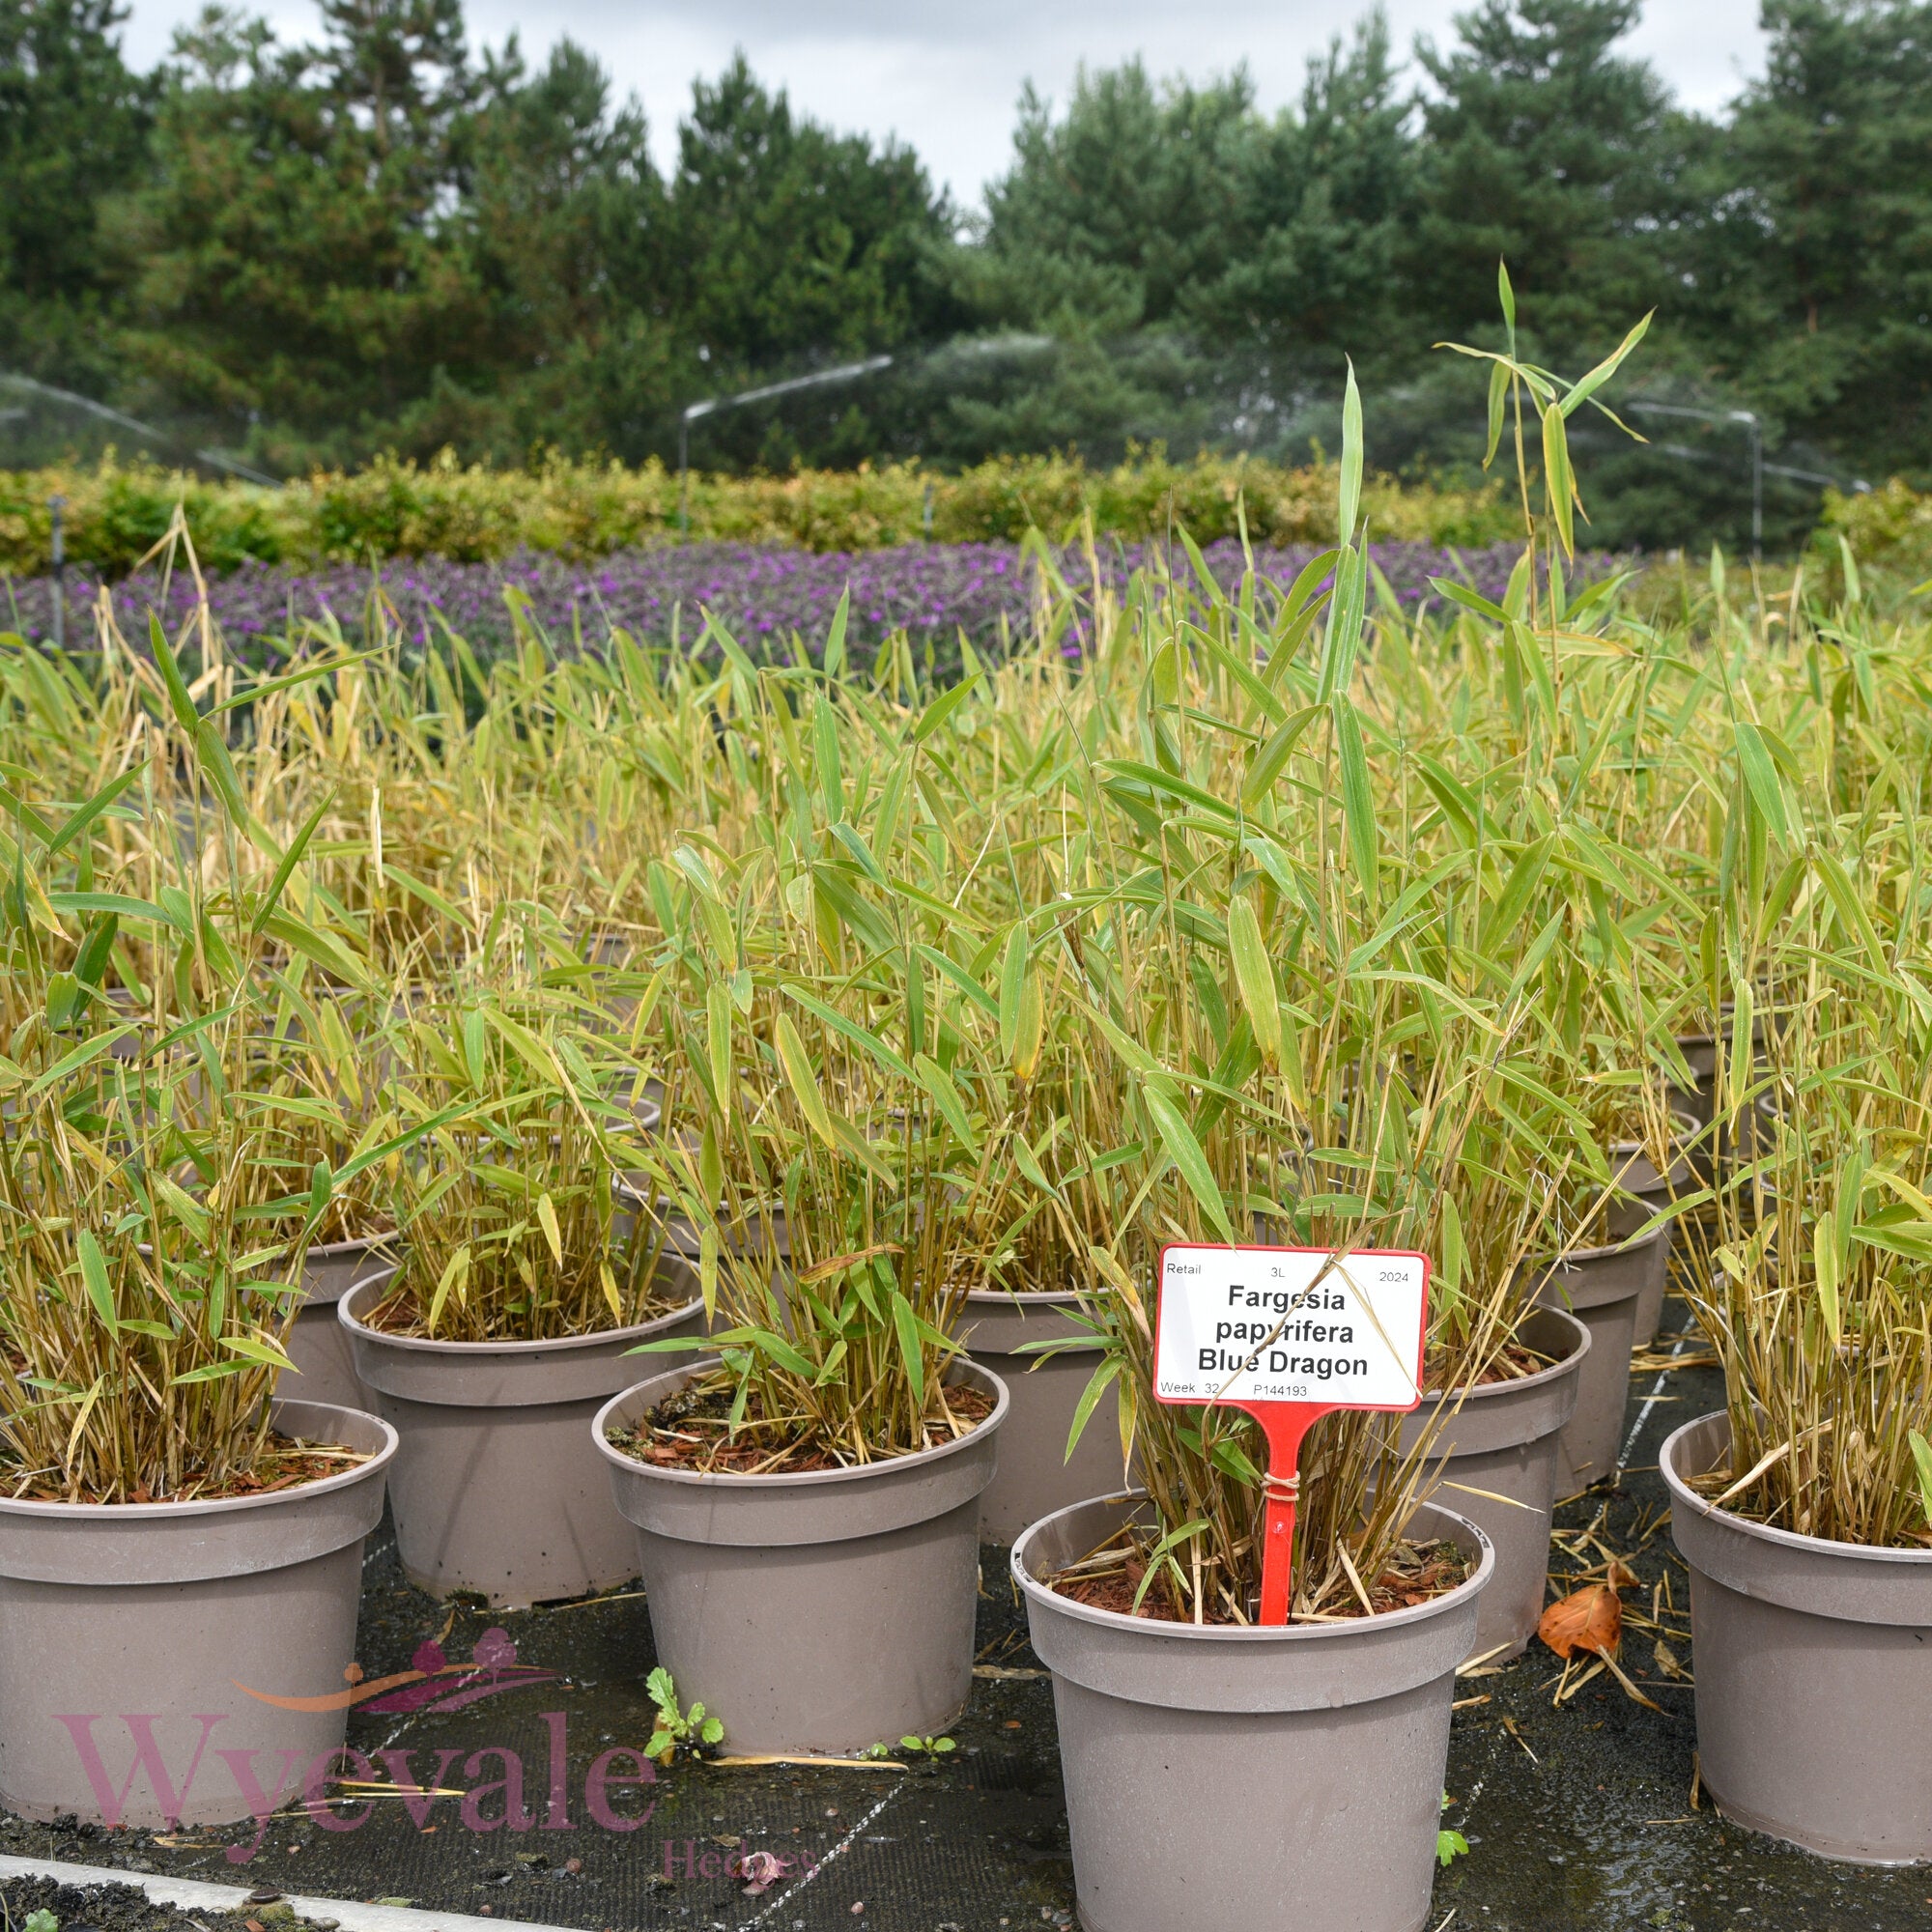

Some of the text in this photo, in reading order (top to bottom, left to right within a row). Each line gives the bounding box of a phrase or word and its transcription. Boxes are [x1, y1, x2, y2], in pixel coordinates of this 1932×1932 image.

[1167, 1263, 1202, 1275] Retail
[1270, 1267, 1286, 1278] 3L
[1379, 1271, 1408, 1283] 2024
[1229, 1285, 1346, 1314] Fargesia
[1199, 1349, 1368, 1380] Blue Dragon
[1160, 1381, 1220, 1394] Week 32
[1253, 1384, 1307, 1397] P144193
